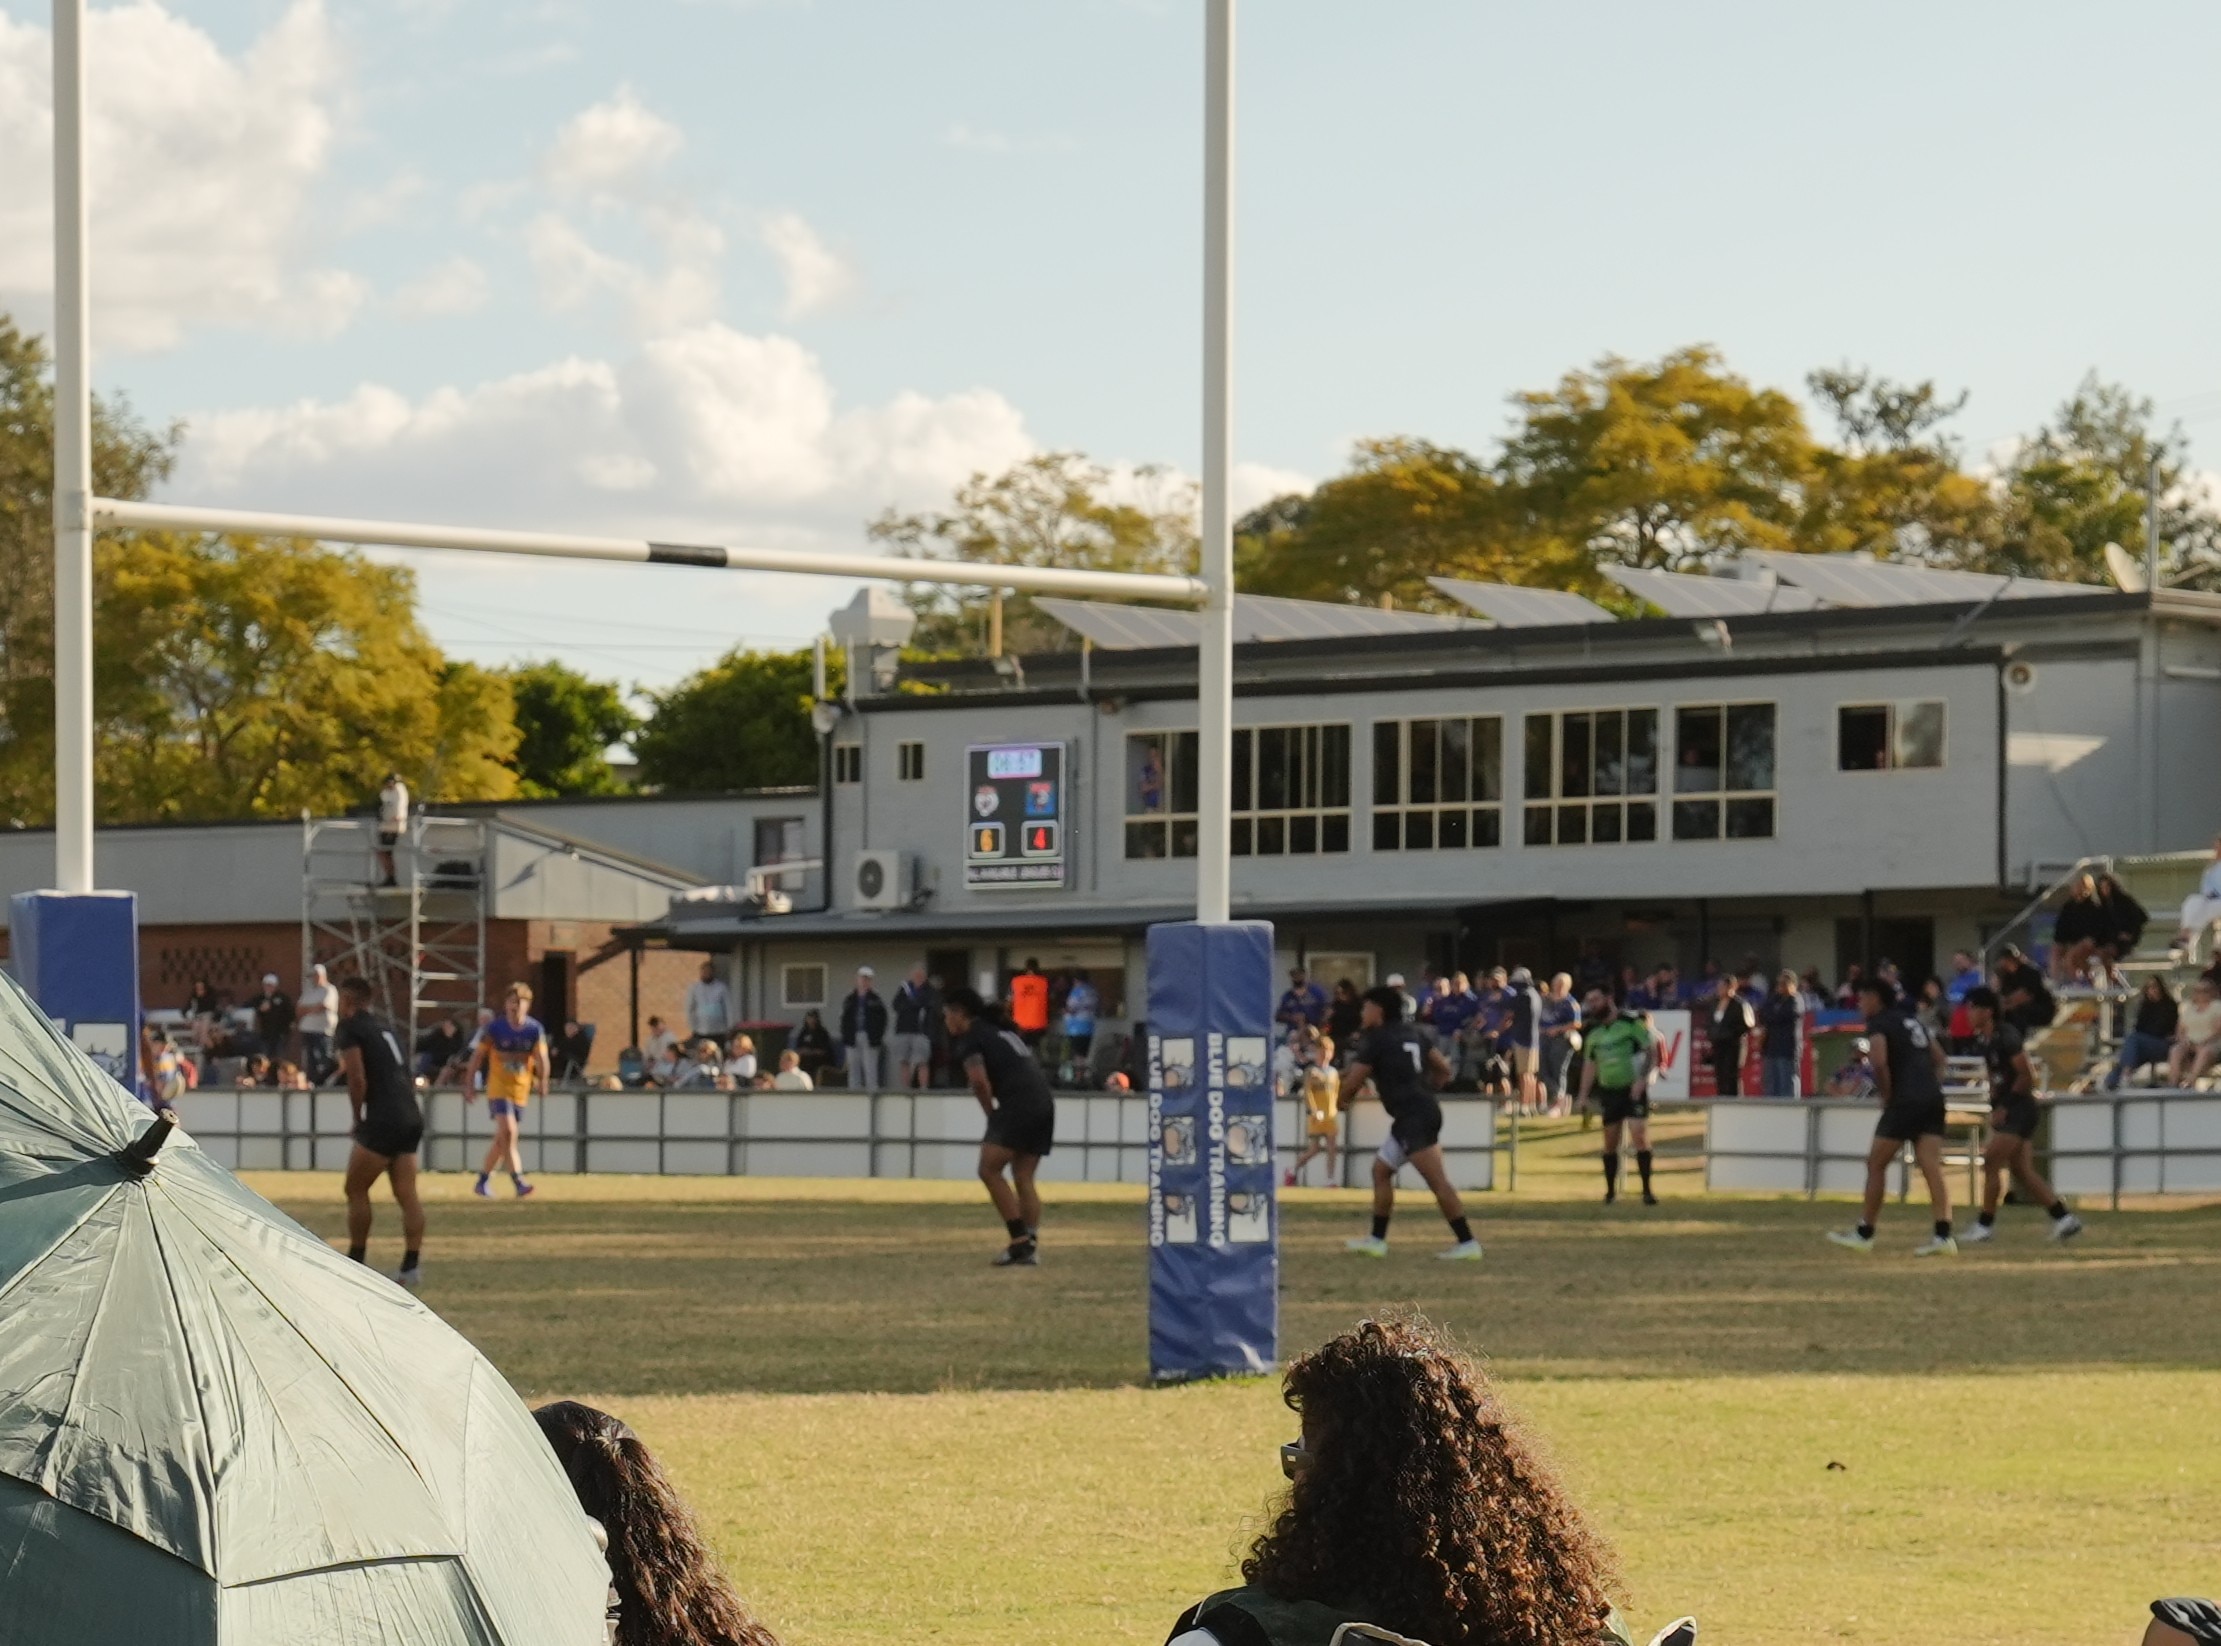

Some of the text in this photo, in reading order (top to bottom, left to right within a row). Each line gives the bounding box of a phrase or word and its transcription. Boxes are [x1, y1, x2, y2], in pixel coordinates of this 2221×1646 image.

[1032, 827, 1046, 850] 4
[381, 1031, 404, 1066] 1
[1148, 1035, 1163, 1090] BLUE
[1402, 1042, 1422, 1073] 7
[1207, 1032, 1226, 1248] BLUE DOG TRAINING
